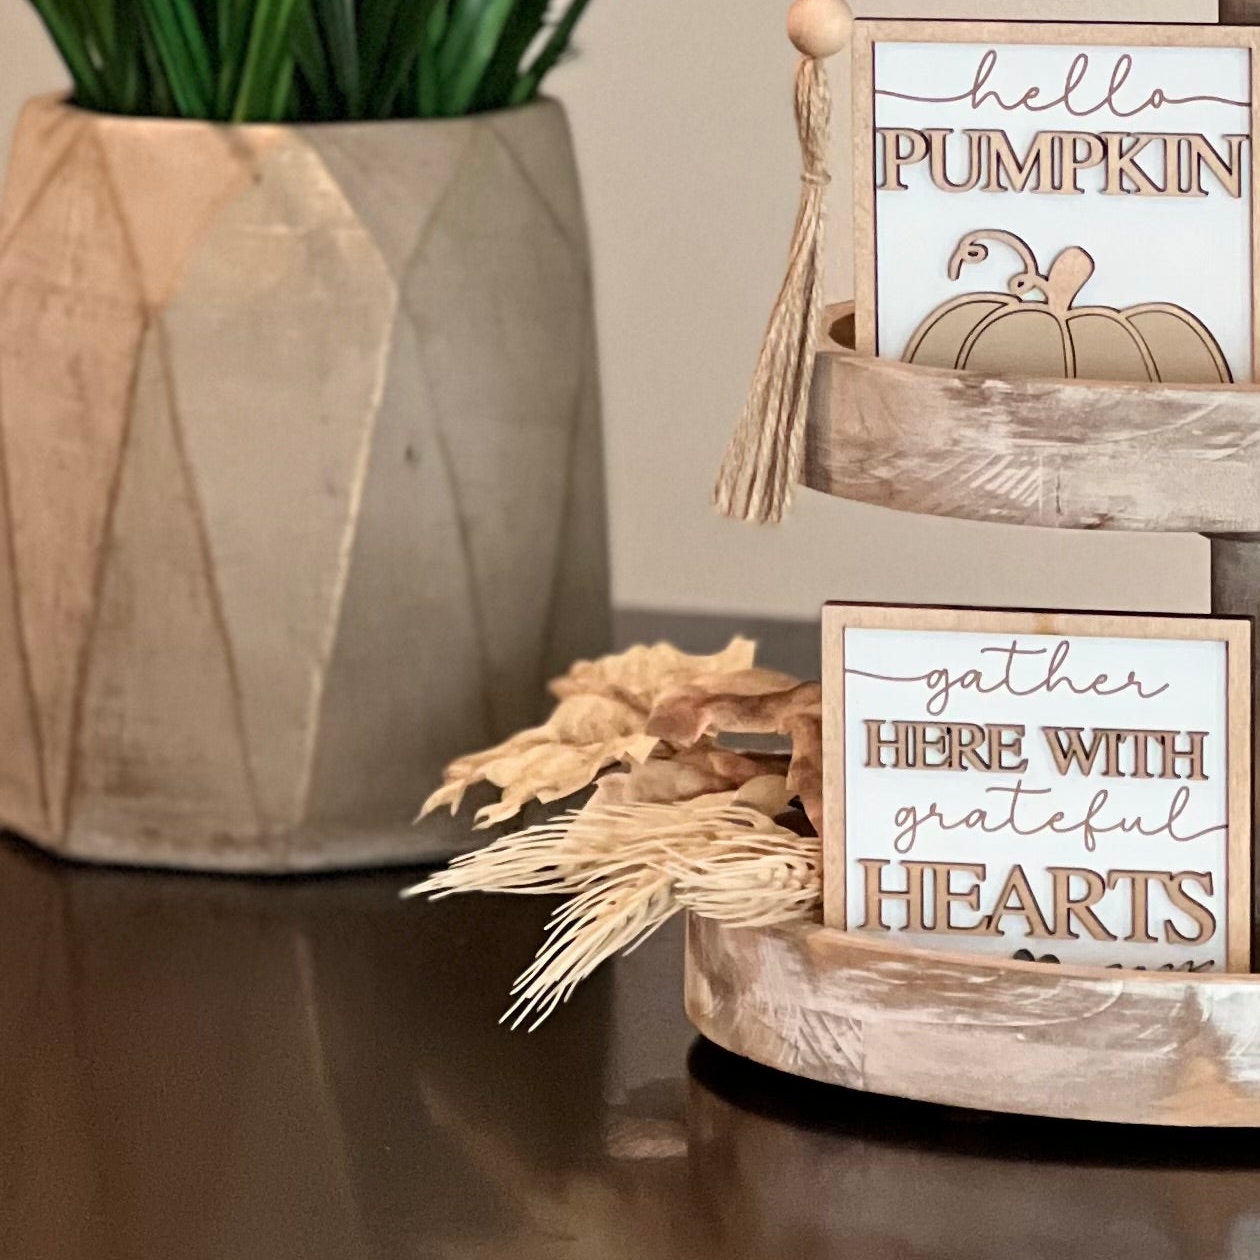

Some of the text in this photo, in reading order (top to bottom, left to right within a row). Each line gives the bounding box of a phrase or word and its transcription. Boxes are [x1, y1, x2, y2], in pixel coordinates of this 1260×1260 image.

[875, 49, 1251, 118] hello
[875, 126, 1252, 199] PUMPKIN
[845, 640, 1170, 716] gather
[863, 719, 1210, 781] HERE WITH
[894, 780, 1229, 854] grateful
[857, 858, 1217, 944] HEARTS
